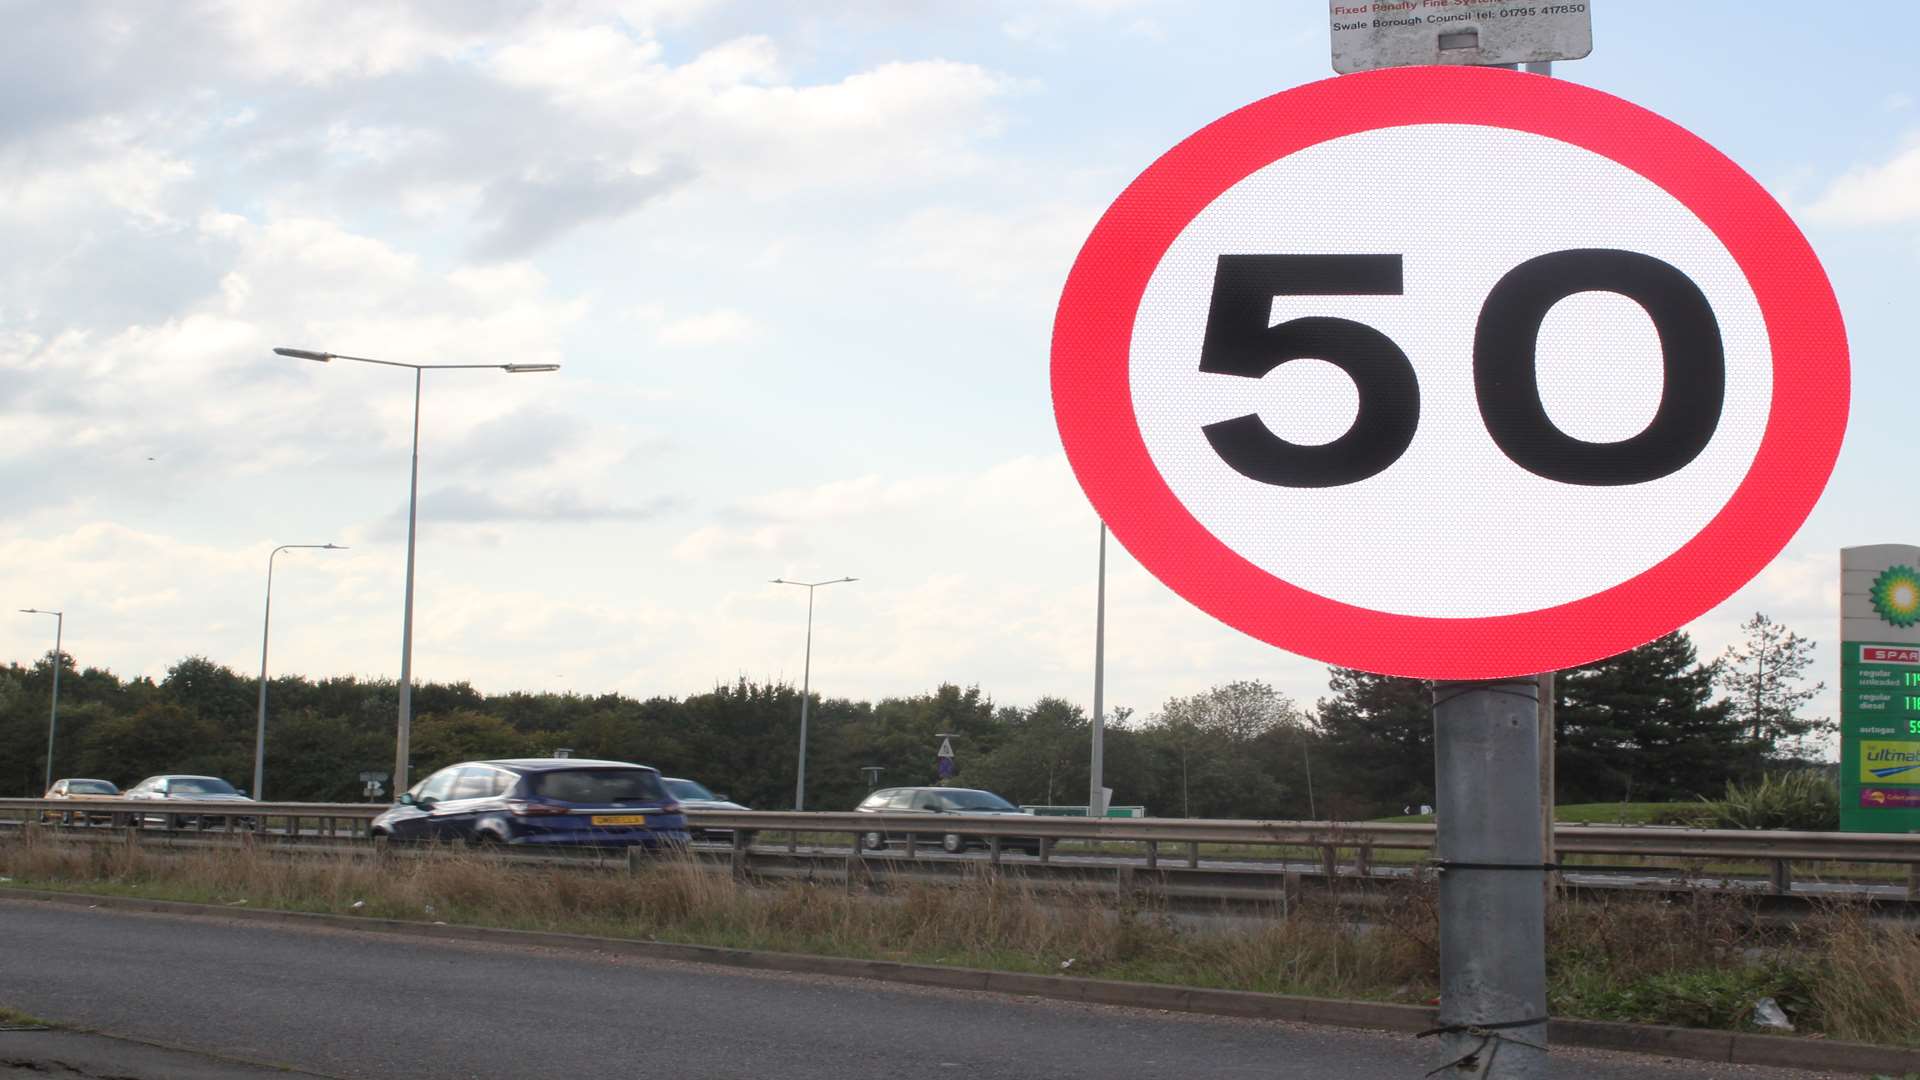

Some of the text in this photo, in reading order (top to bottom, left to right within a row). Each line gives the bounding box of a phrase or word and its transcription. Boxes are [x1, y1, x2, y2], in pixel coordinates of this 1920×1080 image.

[1335, 4, 1367, 15] Fixed
[1372, 1, 1417, 12] Penalty
[1333, 4, 1585, 31] Swale Borough Council tel: 01795 417850
[1199, 248, 1726, 488] 50
[1875, 650, 1918, 661] SPAR
[1859, 670, 1891, 678] regular
[1859, 694, 1891, 702] regular
[1859, 702, 1885, 710] diesel
[1859, 727, 1895, 735] autogas
